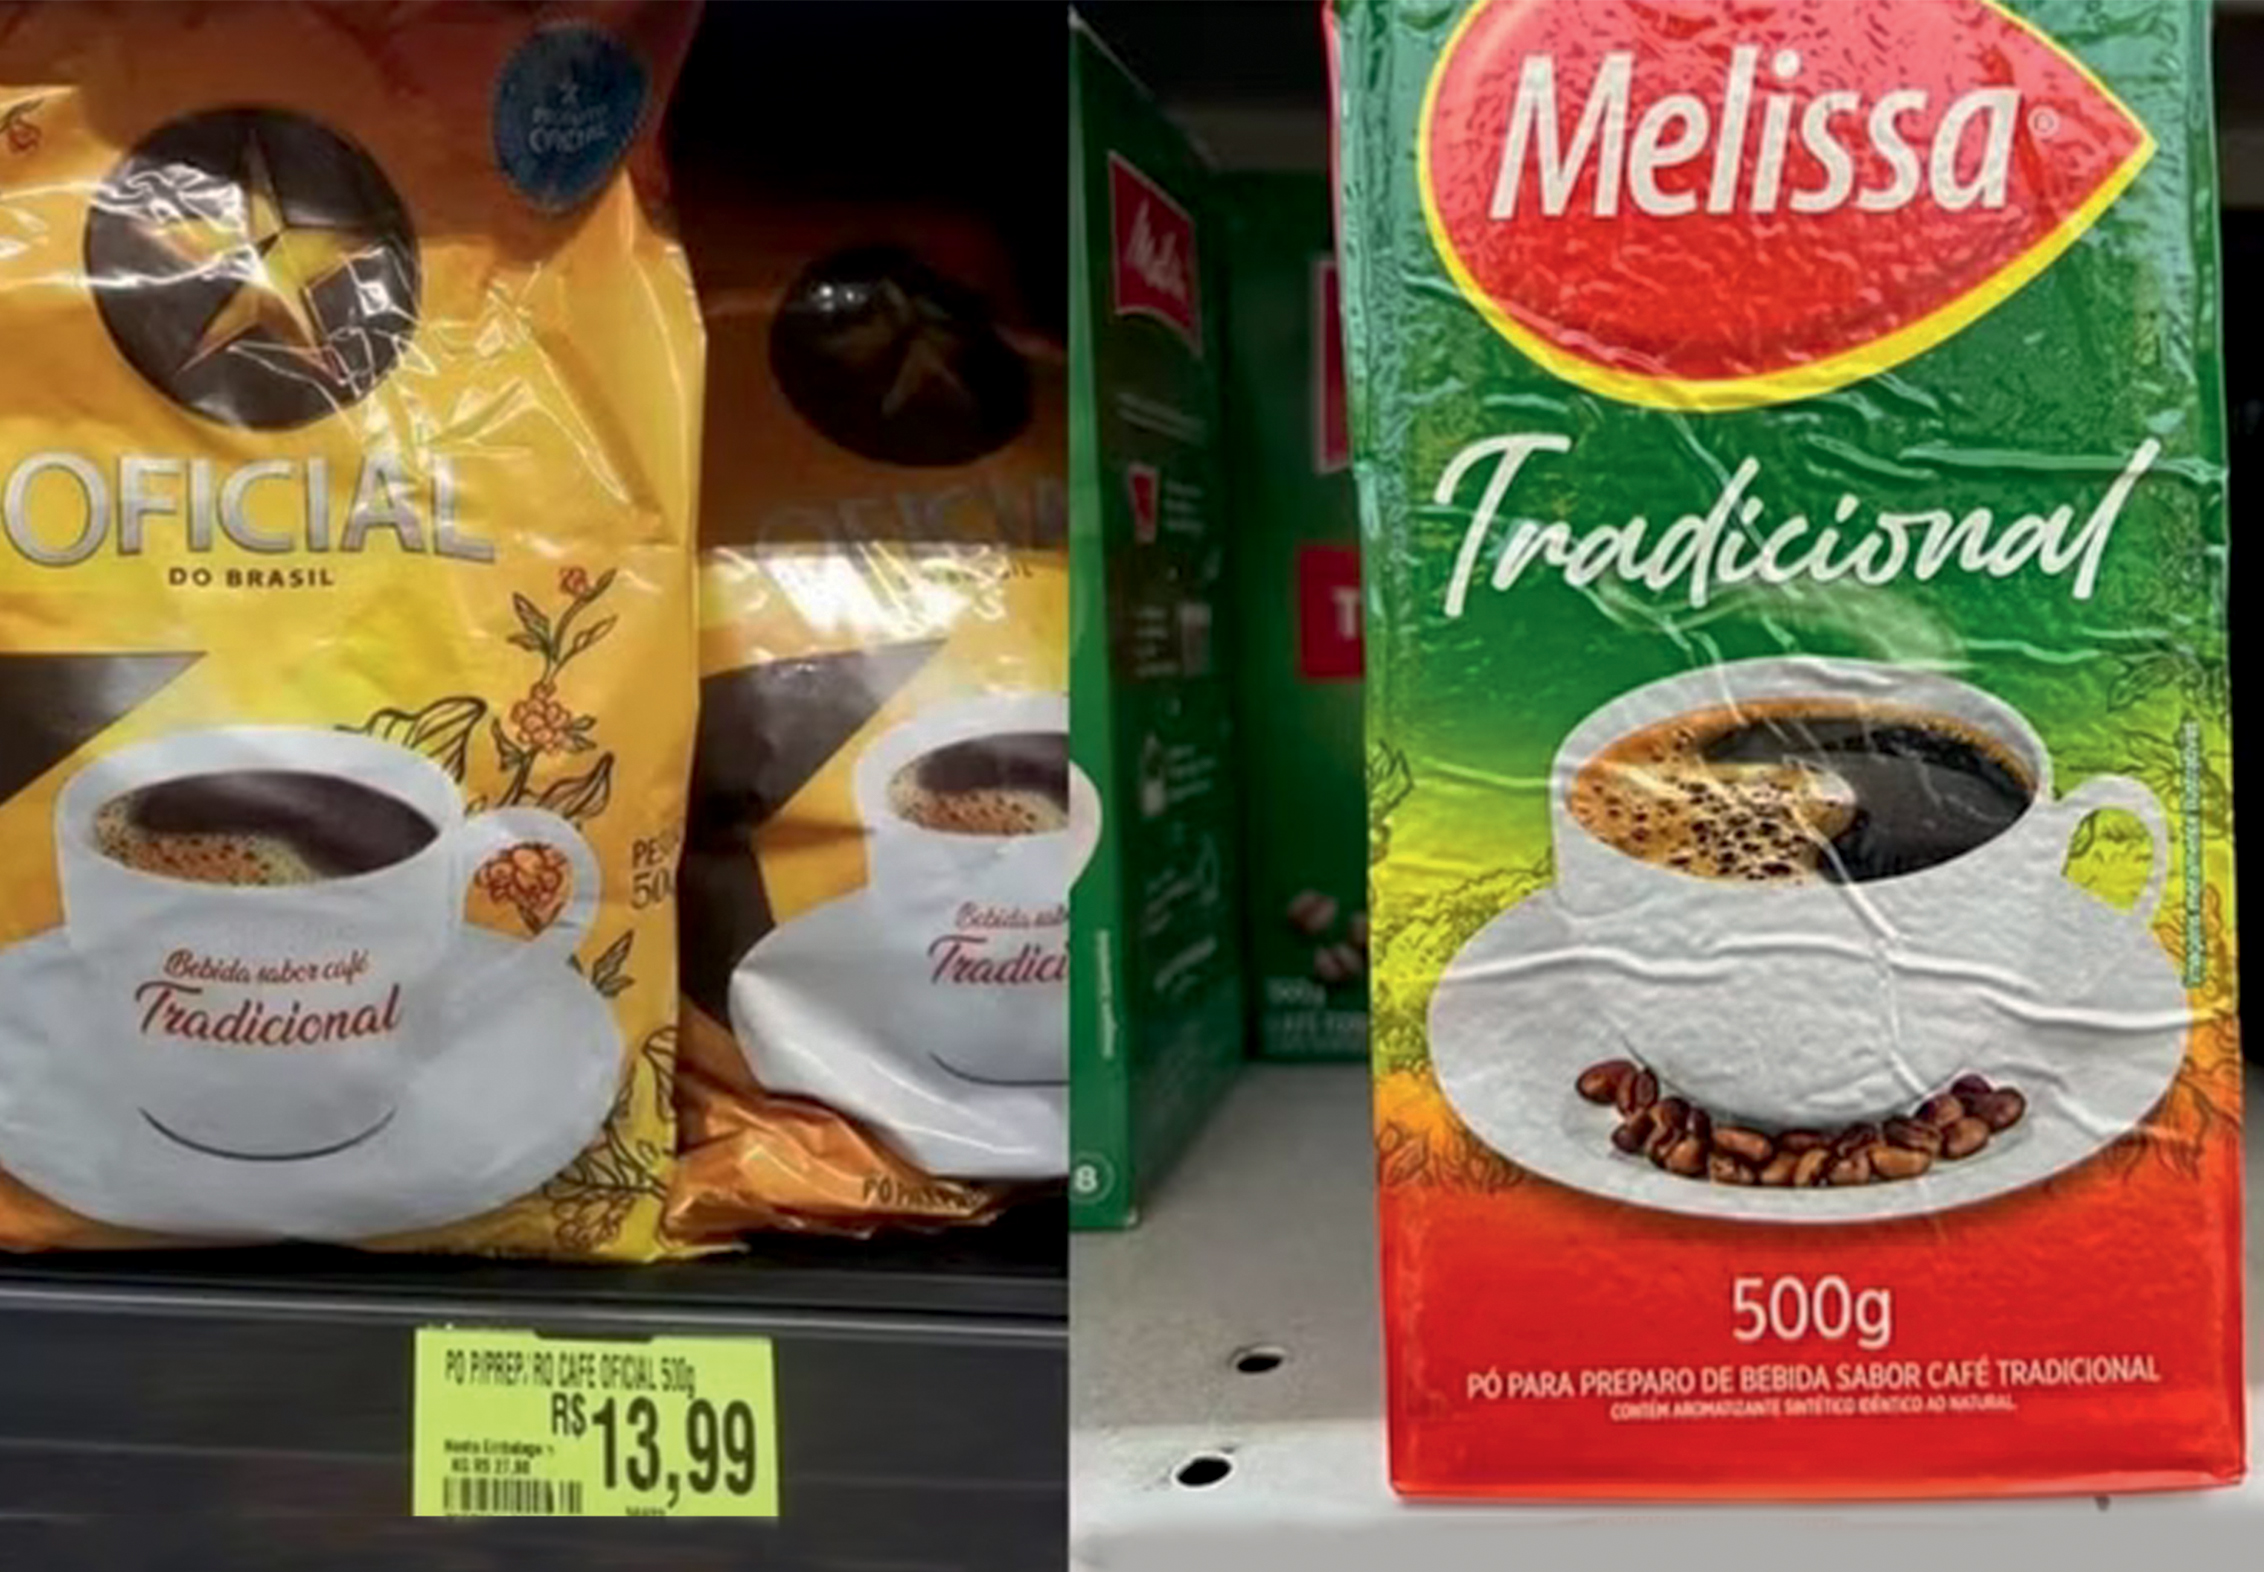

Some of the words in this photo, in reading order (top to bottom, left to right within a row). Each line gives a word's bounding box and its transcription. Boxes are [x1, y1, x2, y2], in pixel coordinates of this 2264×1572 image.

[1489, 45, 2022, 221] Melissa
[2, 450, 496, 567] OFICIAL
[1434, 434, 2162, 617] Tradicional
[168, 566, 212, 588] DO
[226, 567, 335, 589] BRASIL
[164, 948, 251, 983] Bebida
[256, 957, 318, 984] sabor
[321, 949, 369, 987] café
[134, 980, 402, 1046] Tradicional
[1731, 1273, 1894, 1349] 500g
[1467, 1366, 1502, 1399] PÓ
[1508, 1371, 1575, 1398] PARA
[1580, 1367, 1697, 1398] PREPARO
[1702, 1366, 1734, 1394] DE
[1740, 1363, 1831, 1393] BEBIDA
[1836, 1360, 1922, 1391] SABOR
[1927, 1353, 1991, 1389] CAFÉ
[1996, 1354, 2161, 1387] TRADICIONAL
[592, 1396, 757, 1508] 13,99
